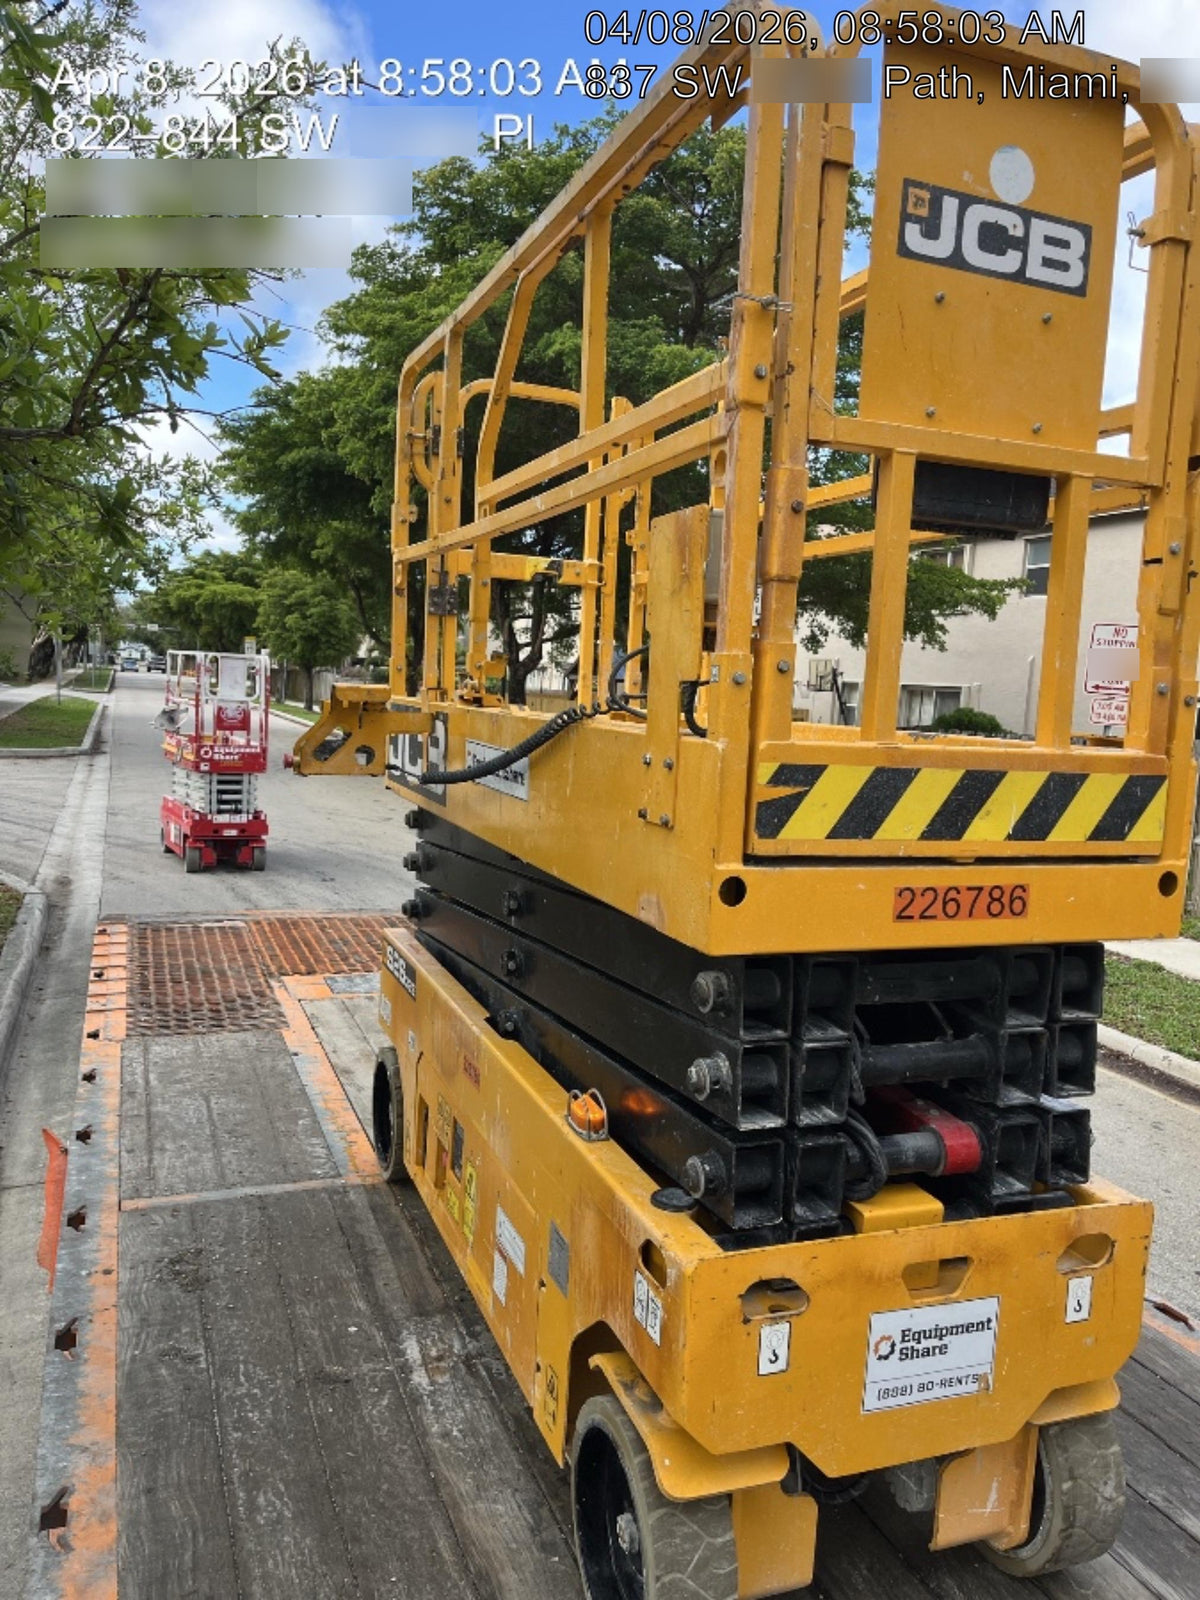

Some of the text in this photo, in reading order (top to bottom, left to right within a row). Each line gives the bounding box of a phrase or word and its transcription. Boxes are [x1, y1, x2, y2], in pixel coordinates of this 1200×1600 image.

[904, 194, 1086, 288] JCB
[1096, 638, 1136, 648] STOPPIN
[1113, 626, 1128, 639] NO
[895, 884, 1027, 920] 226786
[900, 1317, 993, 1344] Equipment
[898, 1343, 949, 1361] Share
